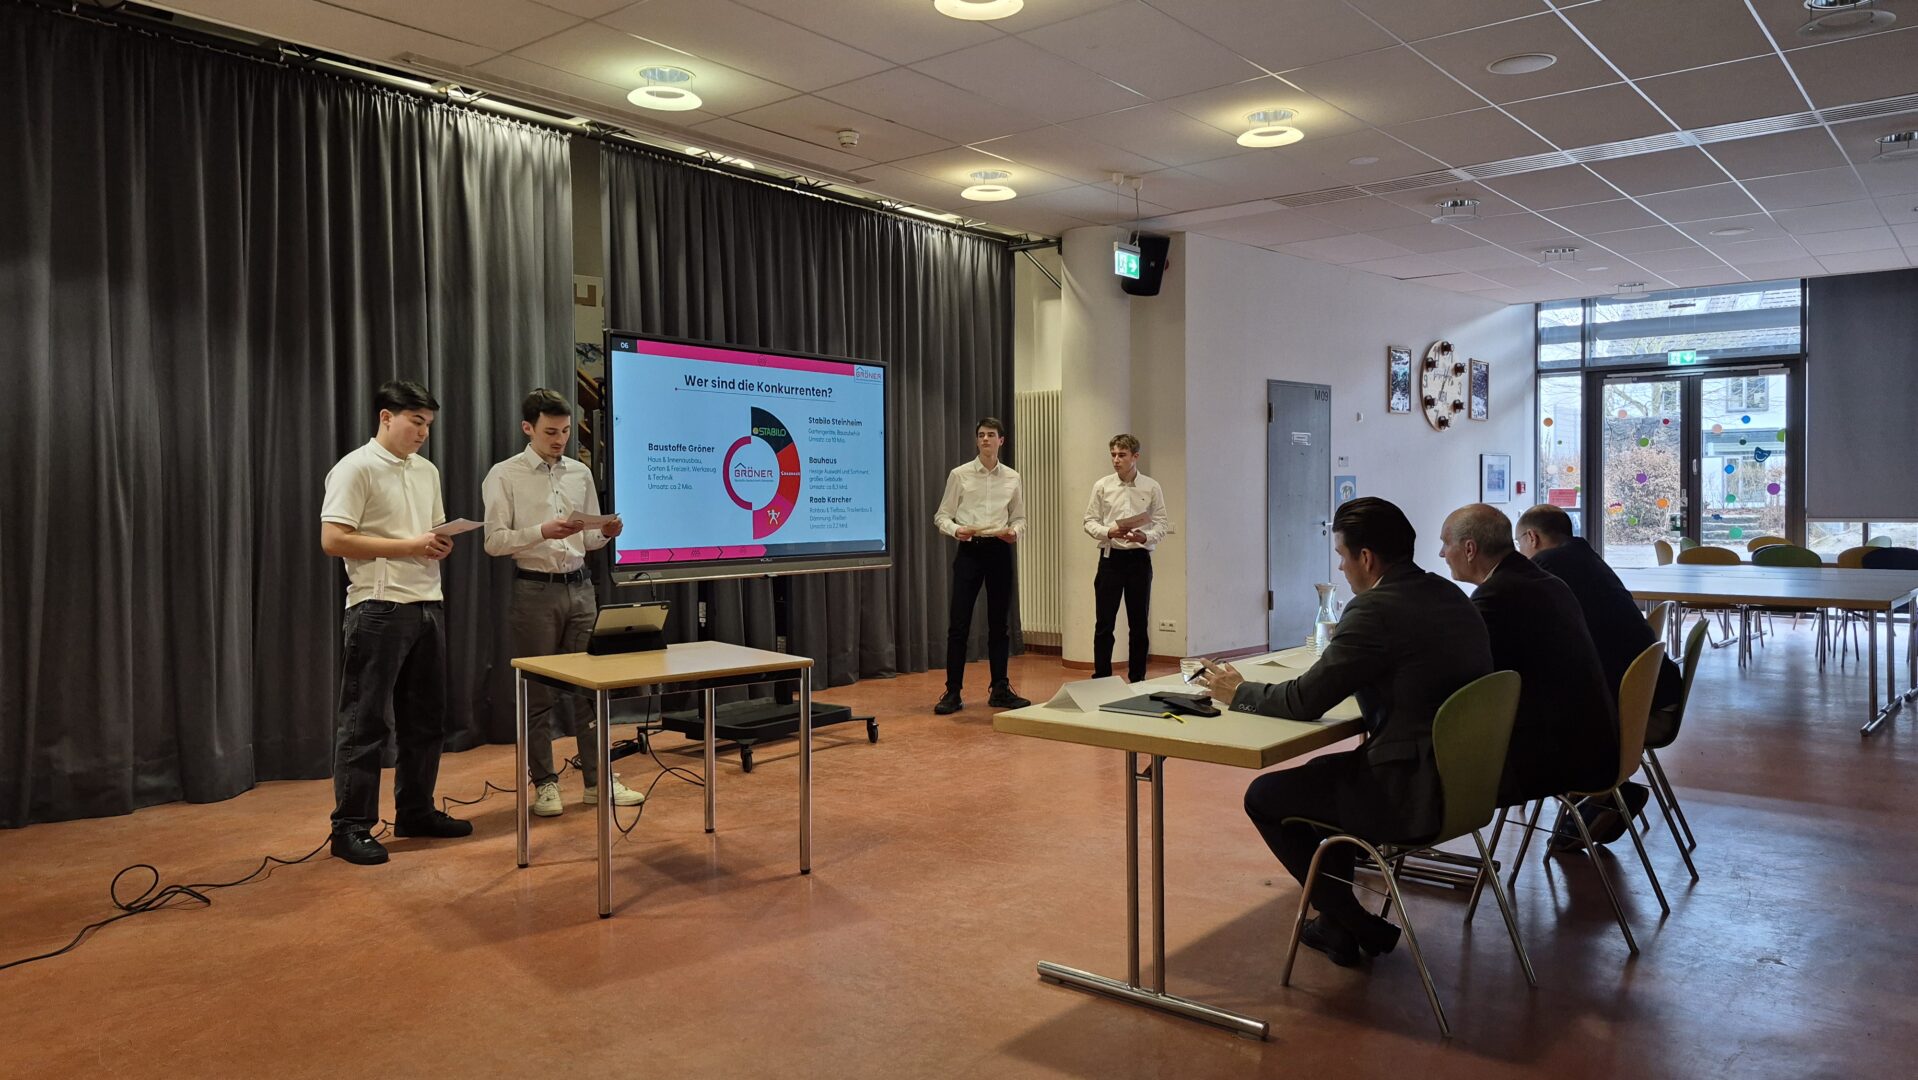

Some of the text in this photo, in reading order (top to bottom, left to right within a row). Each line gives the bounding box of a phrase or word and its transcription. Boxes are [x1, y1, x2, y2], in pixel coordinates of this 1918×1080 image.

[684, 374, 833, 398] Wer sind die Konkurrenten?
[808, 417, 862, 426] Stabilo Steinheim
[759, 427, 786, 437] STABILO
[648, 443, 715, 453] Baustoffe Gröner
[735, 466, 773, 478] GRÖNER
